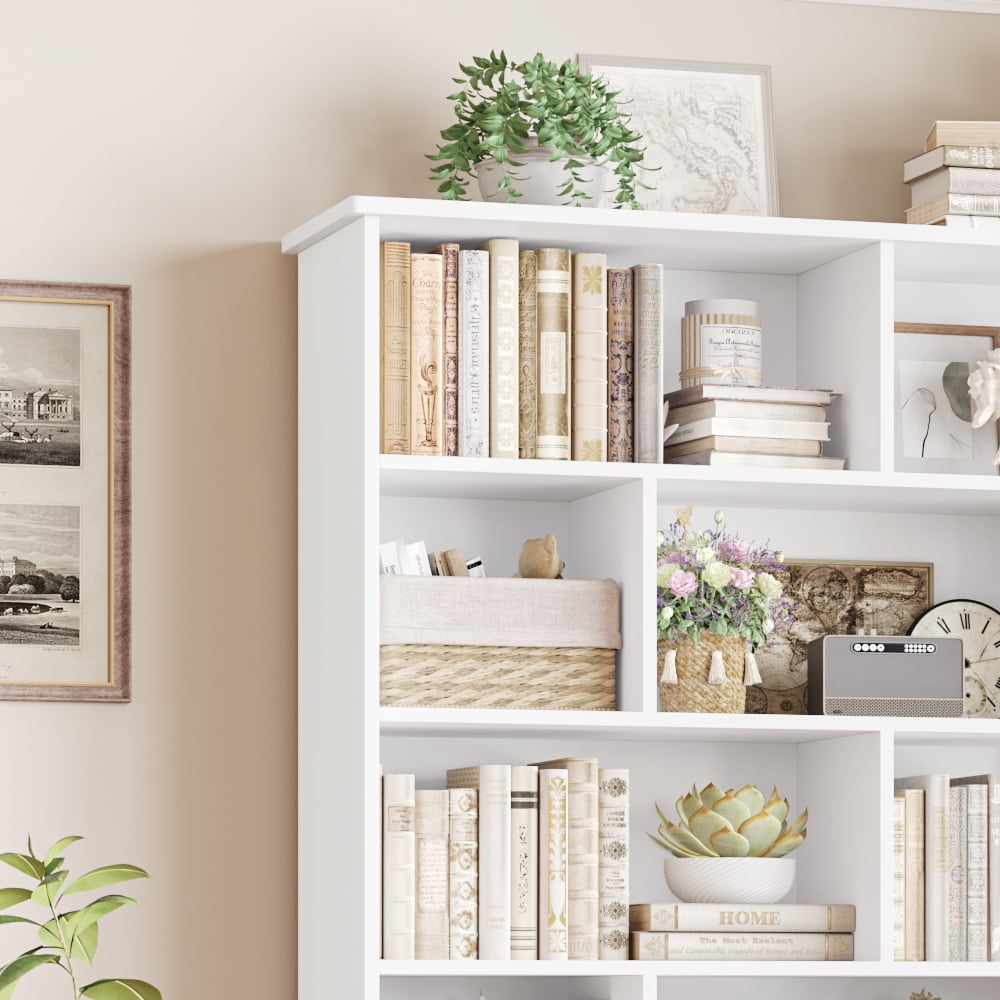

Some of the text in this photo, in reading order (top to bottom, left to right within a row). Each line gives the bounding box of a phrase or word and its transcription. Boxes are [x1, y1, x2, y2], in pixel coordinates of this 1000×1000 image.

[719, 910, 782, 926] HOME
[699, 937, 718, 945] The
[723, 937, 747, 945] Most
